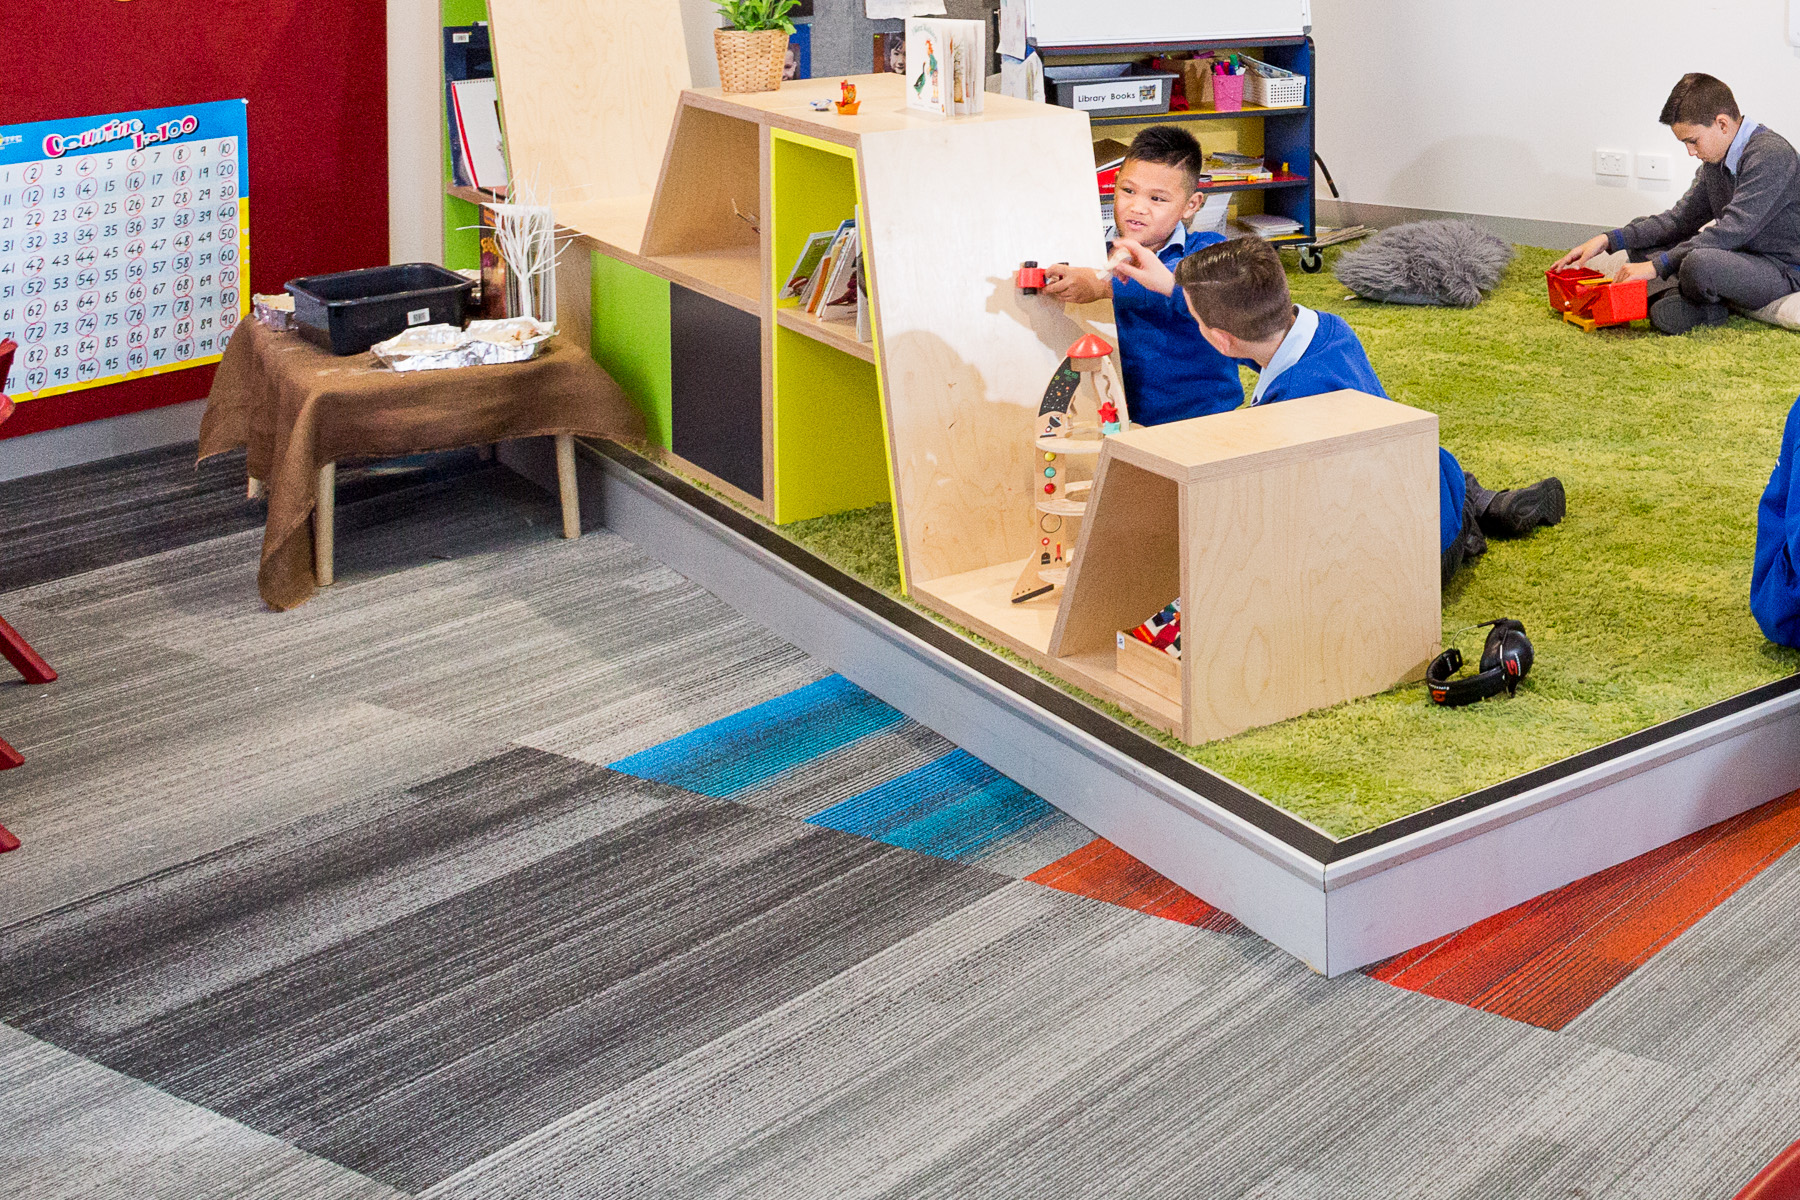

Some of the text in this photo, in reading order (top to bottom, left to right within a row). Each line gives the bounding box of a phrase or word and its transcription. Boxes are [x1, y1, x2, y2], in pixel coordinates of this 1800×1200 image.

[1078, 91, 1136, 104] Library Books
[31, 168, 36, 179] 2
[56, 165, 62, 175] 3
[106, 158, 113, 170] 5
[131, 157, 136, 166] 6
[154, 152, 161, 163] 7
[178, 150, 183, 159] 8
[200, 146, 206, 156] 9
[222, 144, 231, 154] 10
[4, 164, 233, 205] 11 12 13 14 15 16 17 18 19 20
[2, 207, 235, 251] 31 32 33 34 35 36 37 38 39 40
[3, 186, 233, 229] 21 22 23 24 25 26 27 28 29 30
[2, 229, 234, 274] 41 42 43 44 45 46 47 48 49 50
[3, 250, 234, 298] 51 52 53 54 55 56 57 58 59 60
[3, 271, 234, 320] 61 62 63 64 65 66 67 68 69 70
[28, 327, 43, 339] 72
[54, 322, 68, 334] 73
[79, 318, 94, 330] 74
[105, 313, 118, 326] 75
[130, 309, 142, 321] 76
[153, 305, 167, 317] 77
[177, 301, 189, 312] 78
[200, 296, 212, 308] 79
[221, 292, 235, 304] 80
[29, 314, 235, 362] 82 83 84 85 86 87 88 89 90
[29, 372, 43, 384] 92
[54, 367, 69, 379] 93
[78, 363, 95, 374] 94
[106, 358, 118, 369] 95
[130, 353, 142, 365] 96
[153, 348, 166, 360] 97
[177, 344, 190, 355] 98
[200, 339, 212, 350] 99
